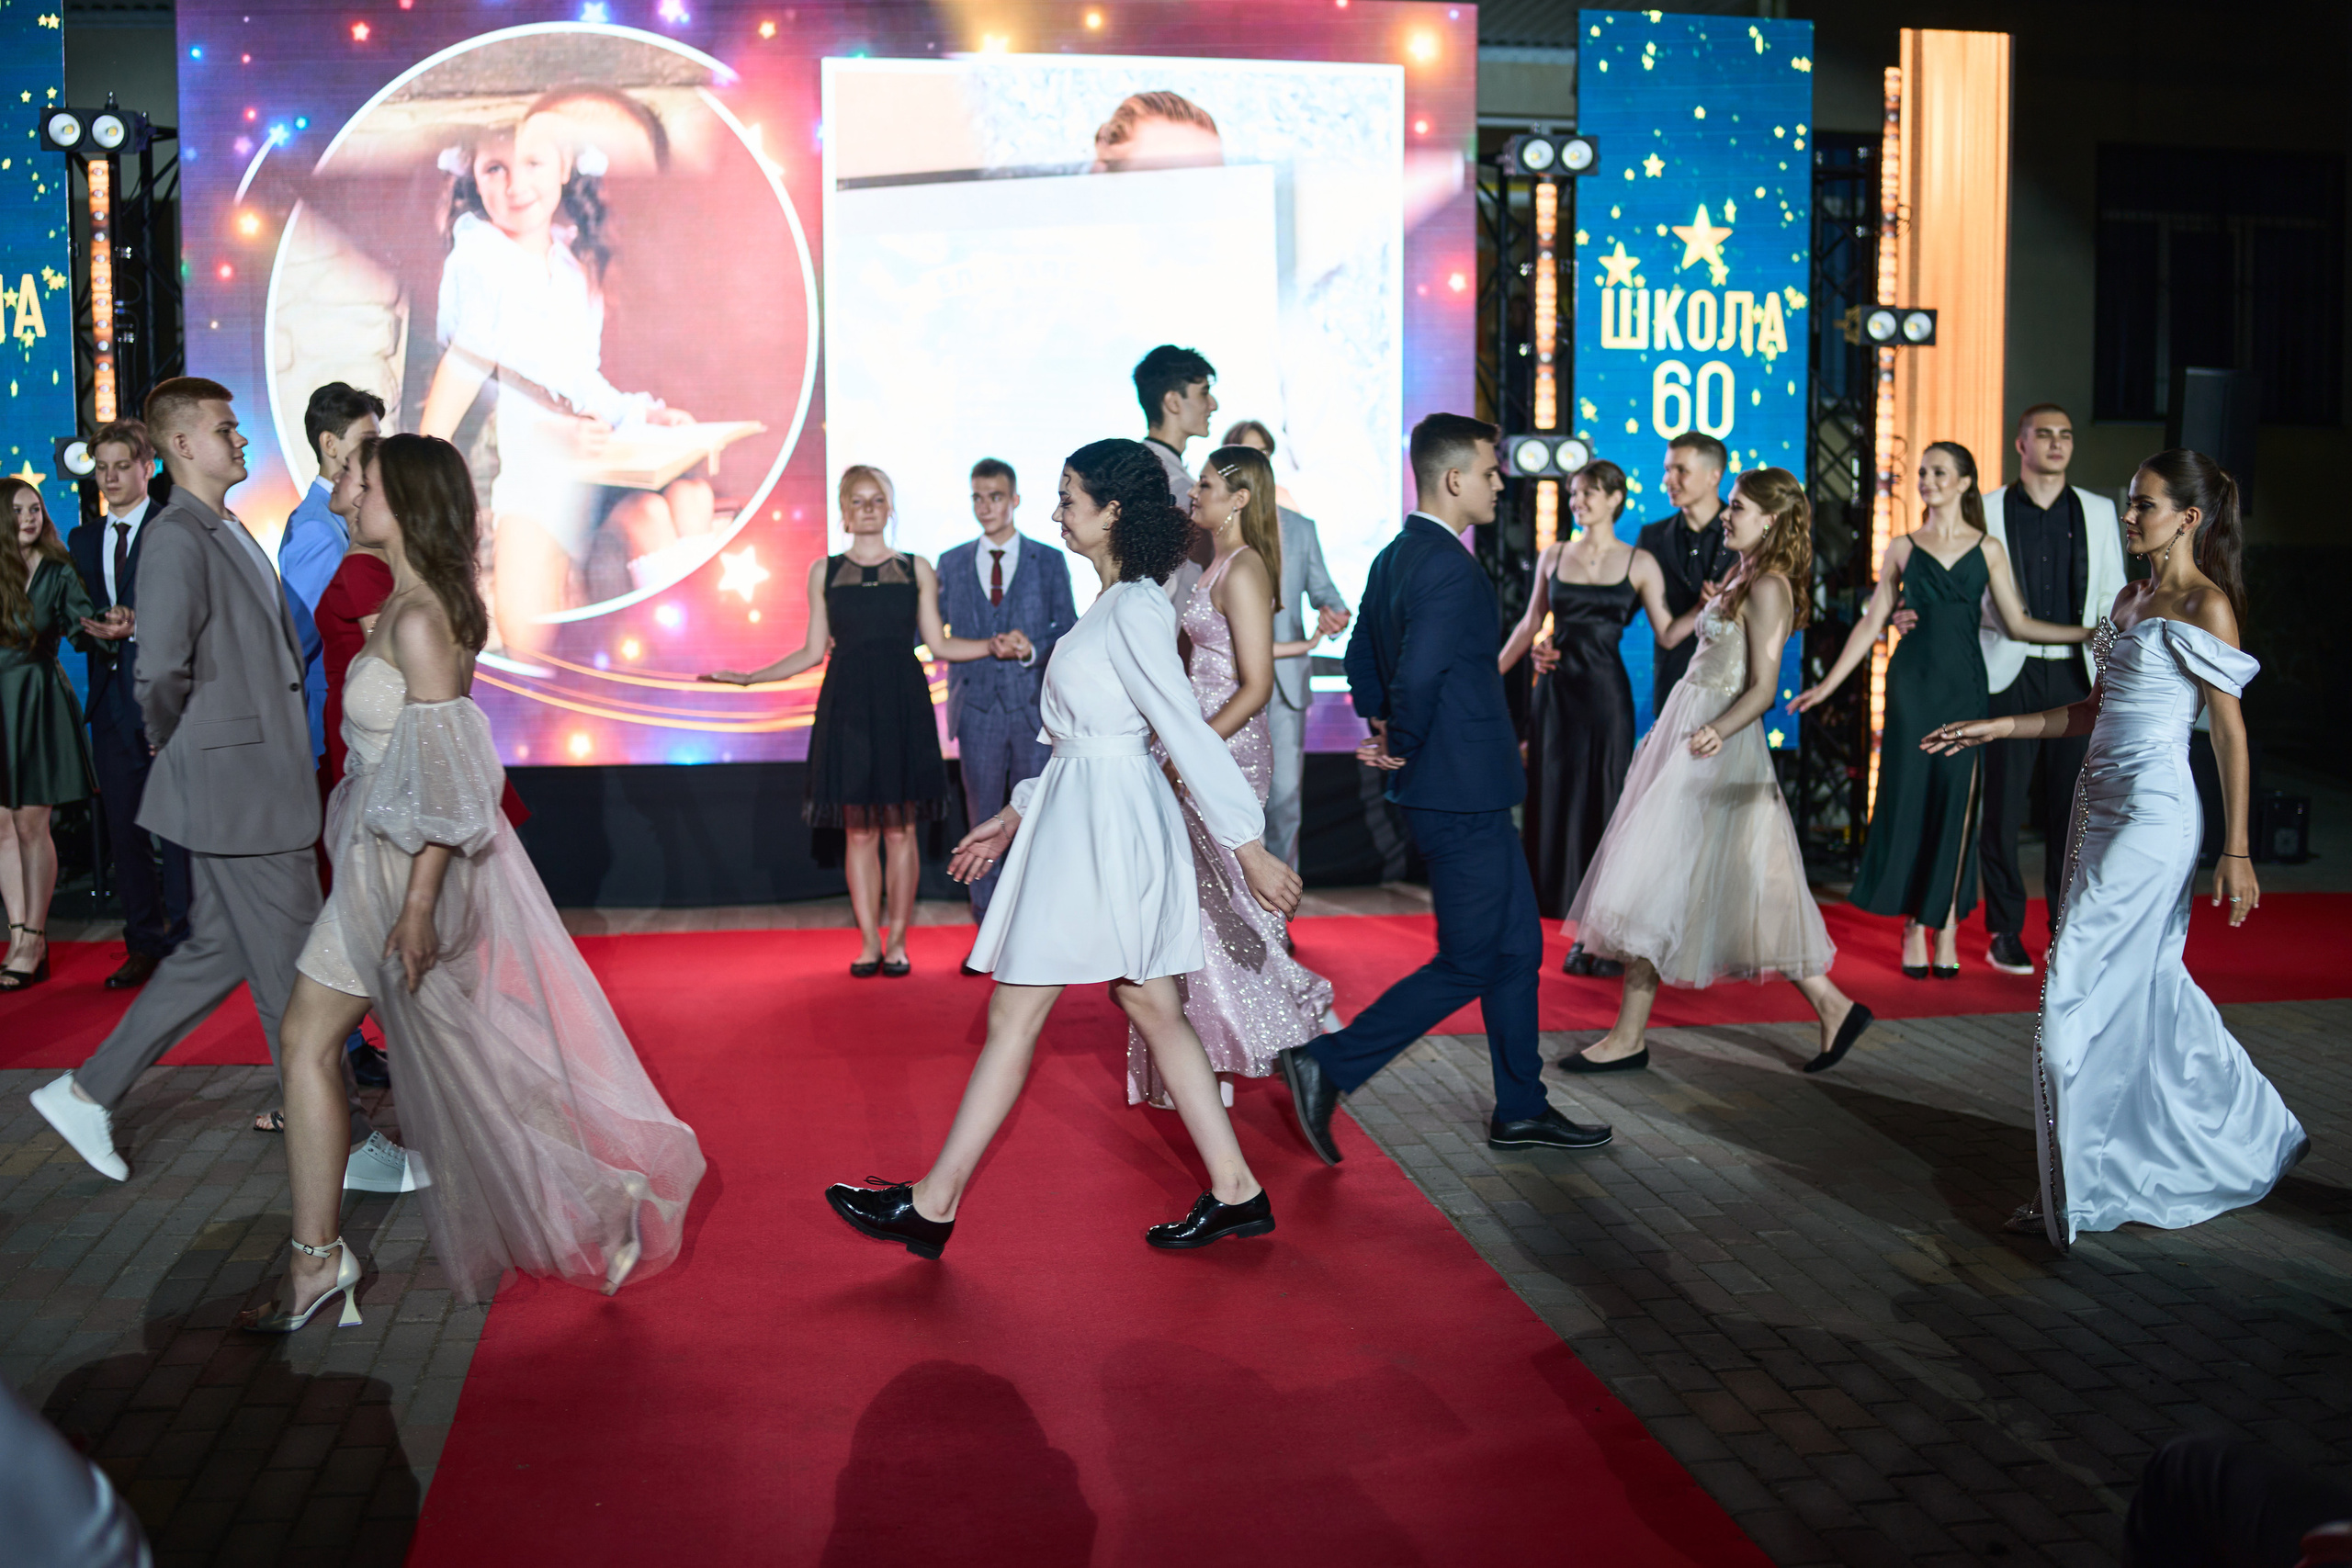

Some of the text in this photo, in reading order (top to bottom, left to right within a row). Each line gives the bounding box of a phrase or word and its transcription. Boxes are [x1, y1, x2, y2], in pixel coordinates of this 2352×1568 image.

[0, 274, 47, 337] А
[1600, 288, 1788, 353] ШКОЛА
[1653, 359, 1736, 441] 60
